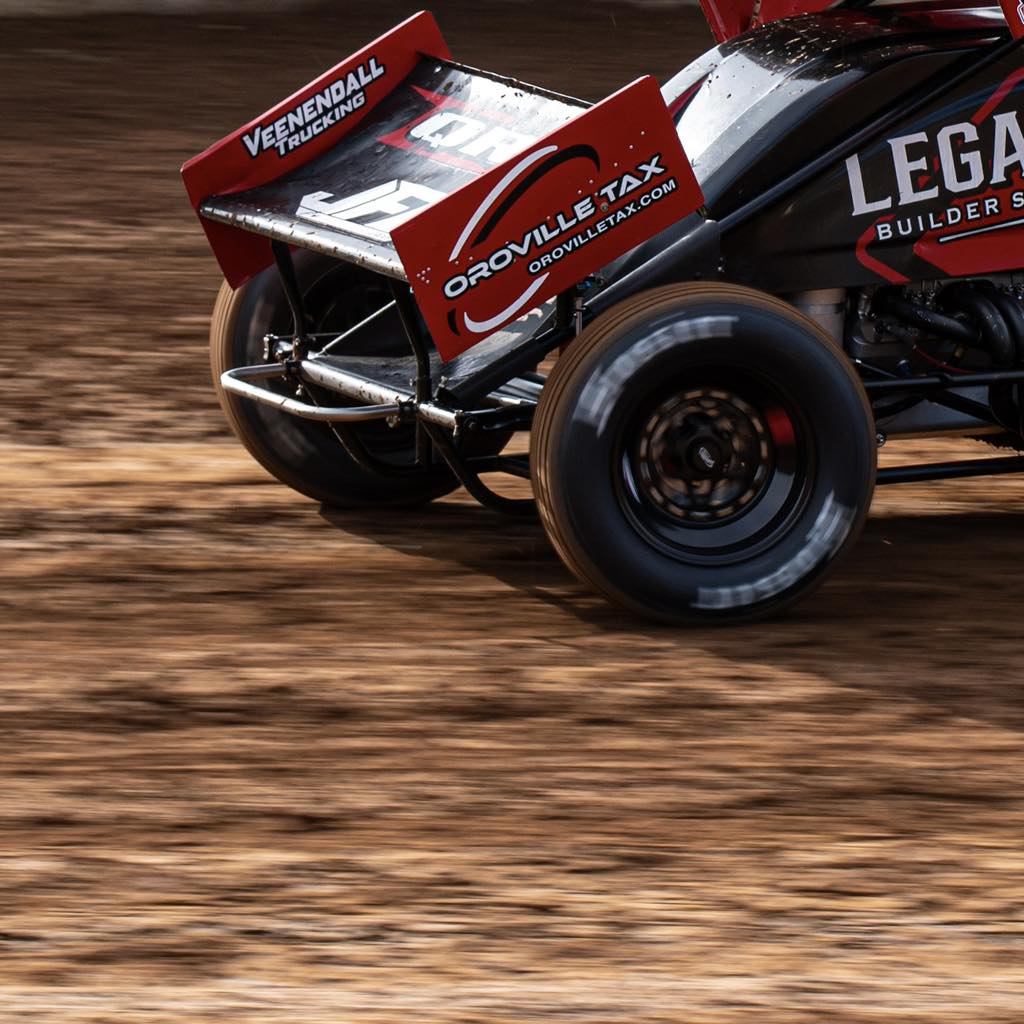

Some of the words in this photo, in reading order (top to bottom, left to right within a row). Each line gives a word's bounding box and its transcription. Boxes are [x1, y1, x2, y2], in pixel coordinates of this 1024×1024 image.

[242, 57, 385, 158] VEENENDALL
[273, 91, 366, 156] TRUCKING
[443, 202, 595, 299] OROVILLE
[600, 155, 665, 207] TAX
[528, 179, 676, 275] OROVILLETAX.COM
[877, 198, 1000, 241] BUILDER
